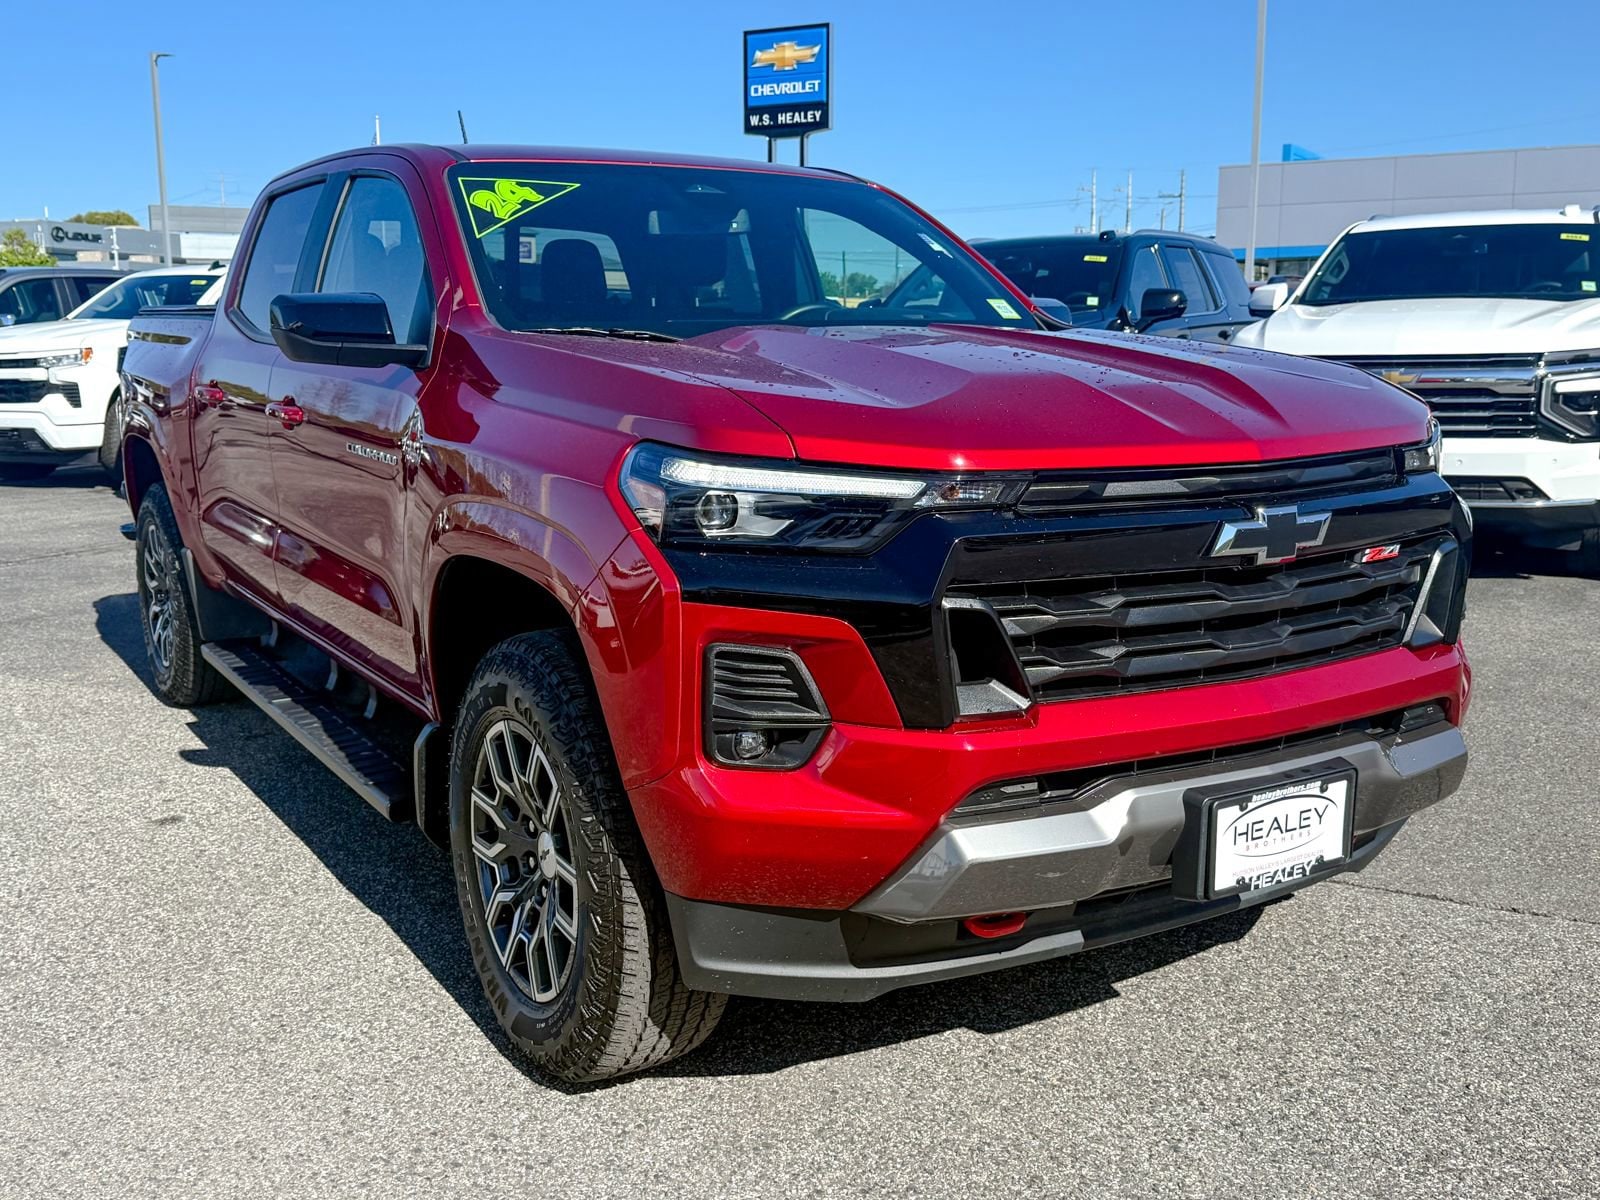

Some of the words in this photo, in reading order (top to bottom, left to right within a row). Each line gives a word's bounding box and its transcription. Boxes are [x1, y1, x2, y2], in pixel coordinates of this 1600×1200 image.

[750, 80, 822, 97] CHEVROLET
[749, 113, 774, 127] W.S.
[777, 110, 822, 125] HEALEY
[1233, 803, 1330, 846] HEALEY
[1245, 830, 1312, 852] BROTHERS
[1250, 860, 1313, 892] HEALEY
